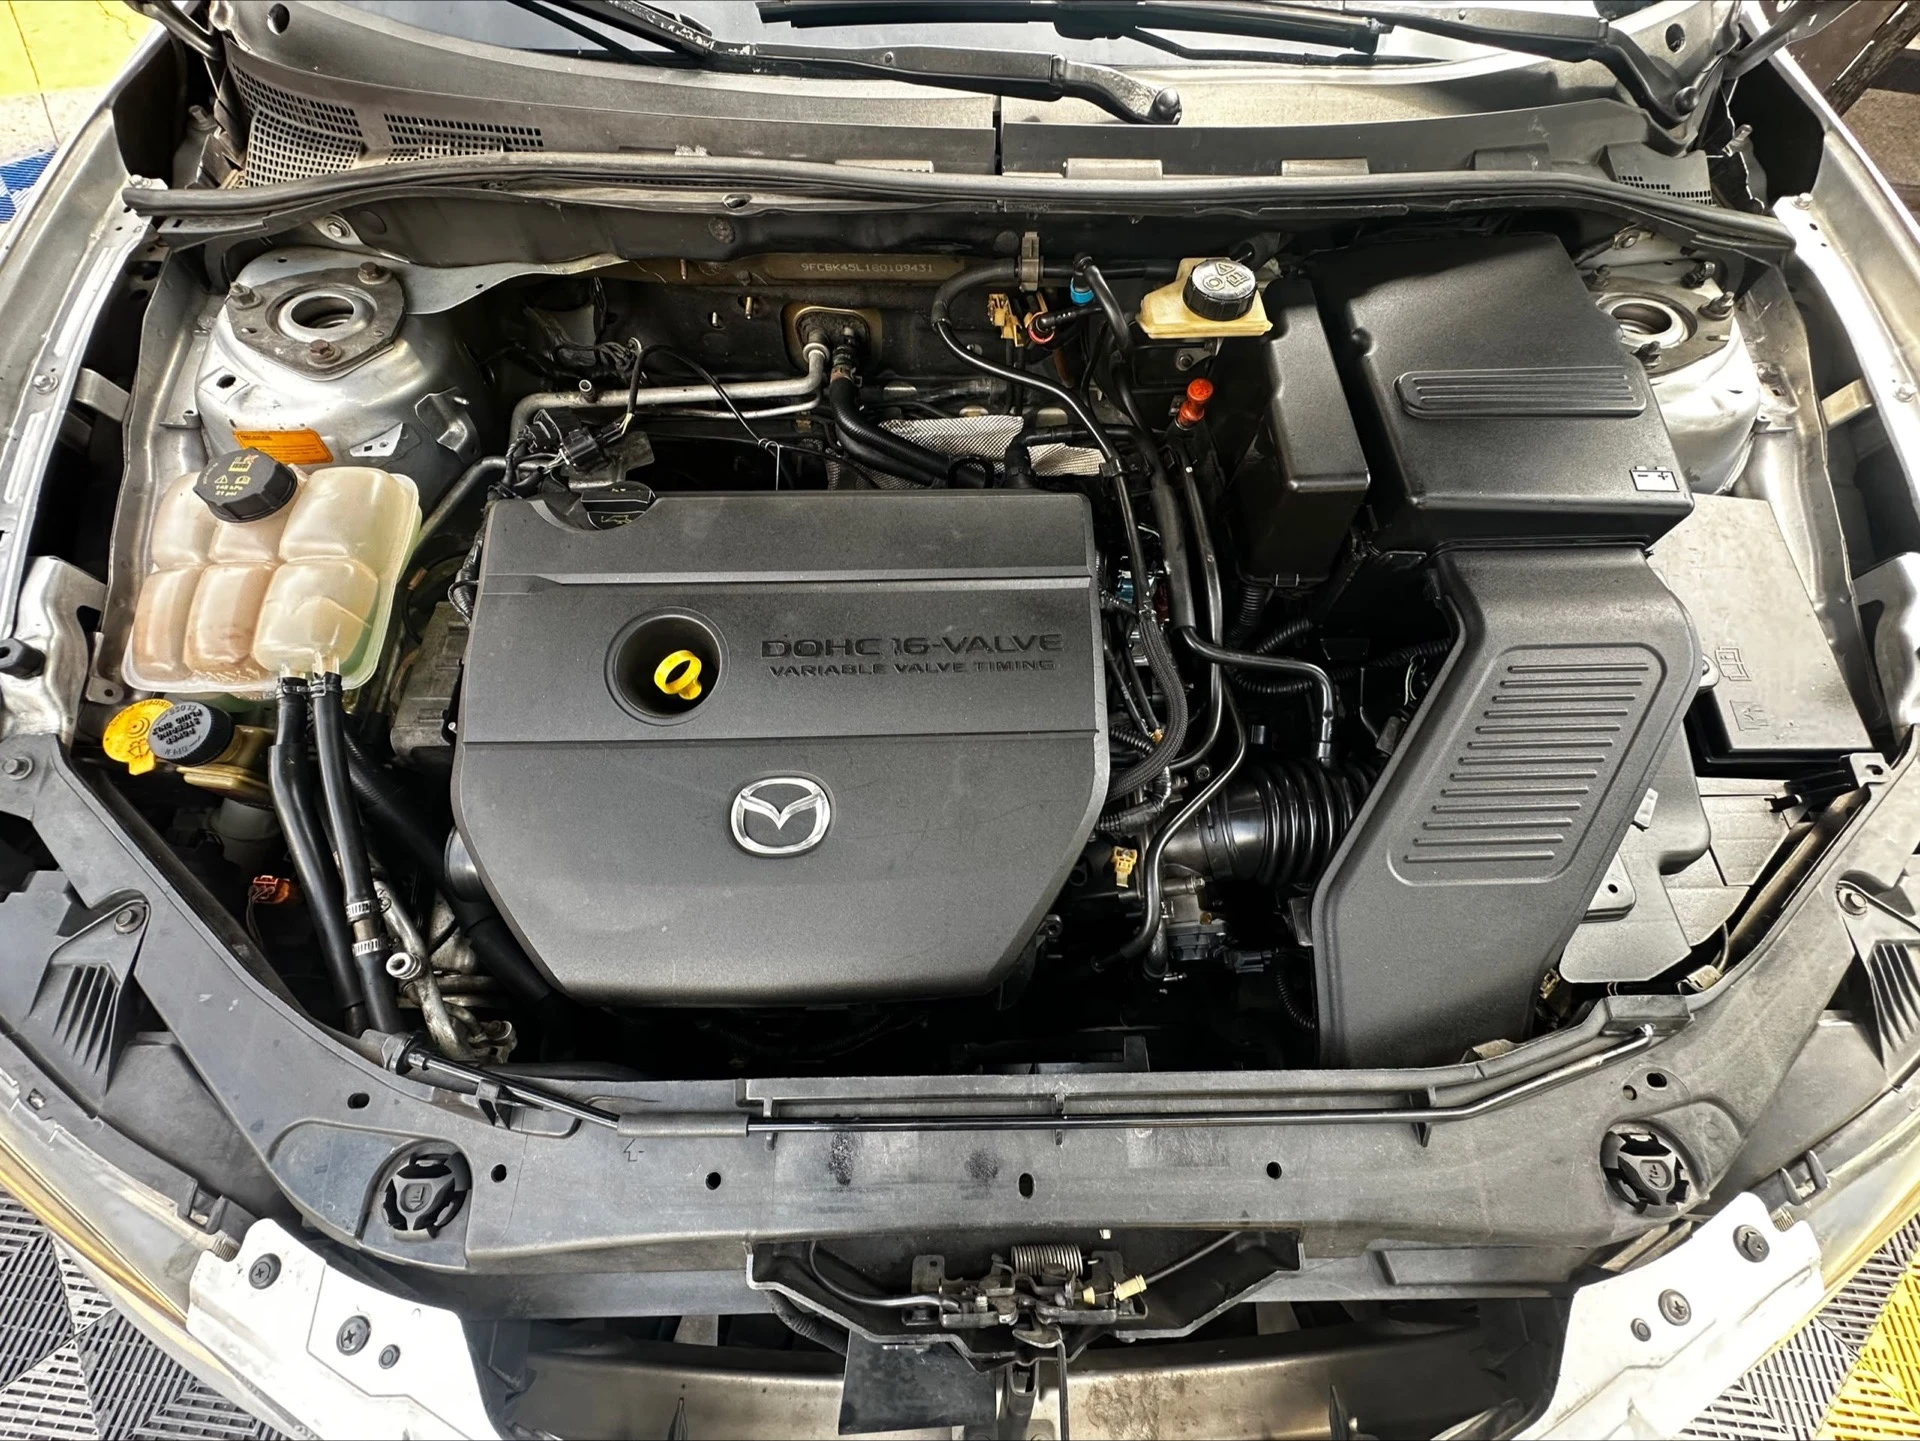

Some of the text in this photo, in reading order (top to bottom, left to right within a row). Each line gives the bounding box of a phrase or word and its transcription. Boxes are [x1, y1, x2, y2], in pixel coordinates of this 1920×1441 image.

[761, 634, 1064, 658] DOHC 16-VALVE
[769, 660, 1056, 677] VARIABLE VALVE TIMING
